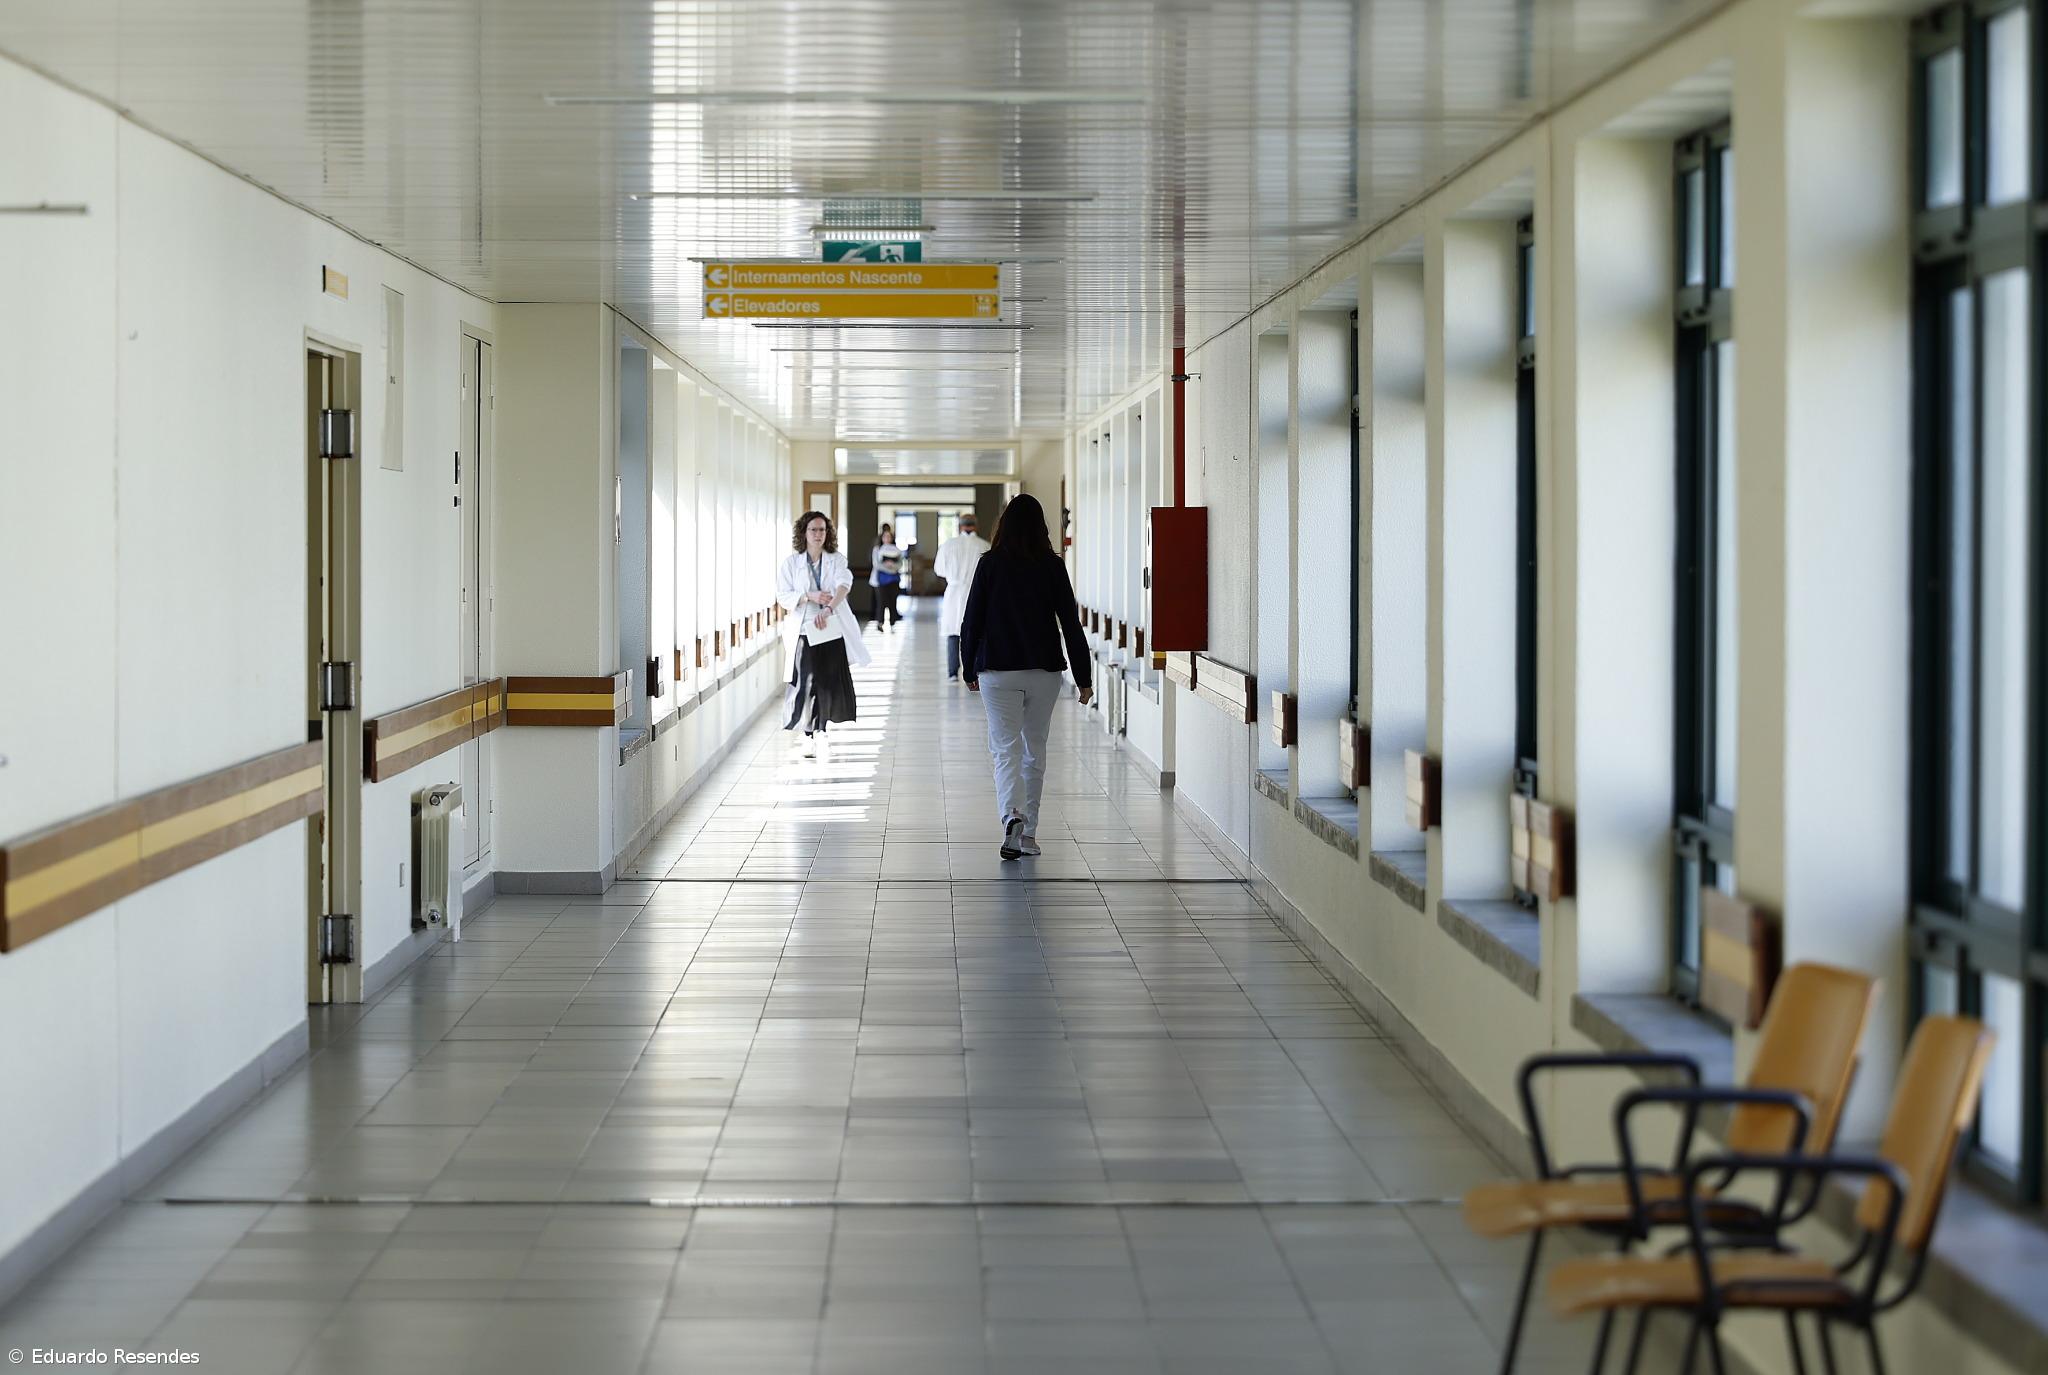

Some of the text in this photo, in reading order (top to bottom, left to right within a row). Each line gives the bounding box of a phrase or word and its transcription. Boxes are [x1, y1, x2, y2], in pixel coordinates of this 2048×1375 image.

[733, 268, 922, 285] Internamentos Nascente
[733, 298, 820, 314] Elevadores
